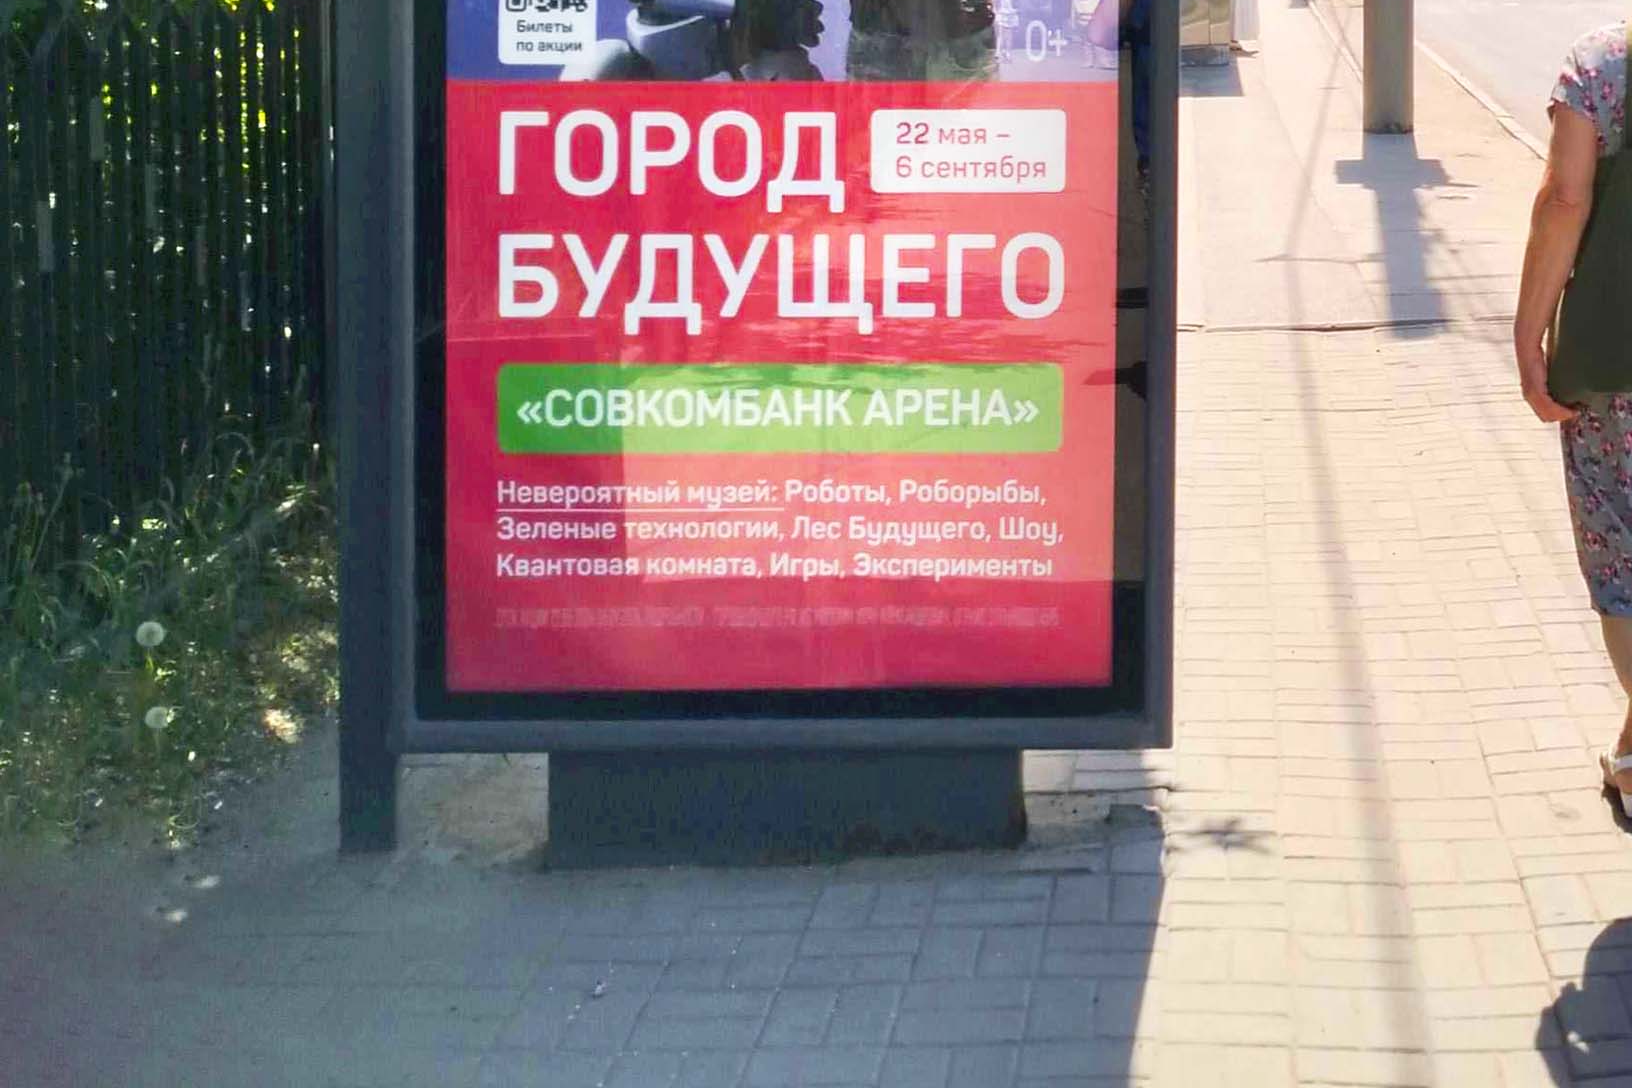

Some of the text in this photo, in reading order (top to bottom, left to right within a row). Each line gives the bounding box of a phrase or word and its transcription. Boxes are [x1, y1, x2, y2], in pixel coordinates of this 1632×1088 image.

[516, 19, 573, 33] Билеты
[516, 41, 582, 53] по акции
[1025, 20, 1068, 62] 0+
[895, 122, 930, 145] 22
[937, 127, 987, 145] мая
[498, 109, 845, 213] ГОРОД
[895, 155, 1047, 183] 6 сентября
[498, 232, 1065, 335] БУДУЩЕГО
[516, 388, 1040, 428] «СОВКОМБАНК АРЕНА»
[496, 479, 1047, 509] Невероятный музей: Роботы, Роборыбы,
[496, 516, 1064, 545] Зеленые технологии, Лес Будущего, Шоу,
[496, 553, 1052, 582] Квантовая комната, Игры, Эксперименты
